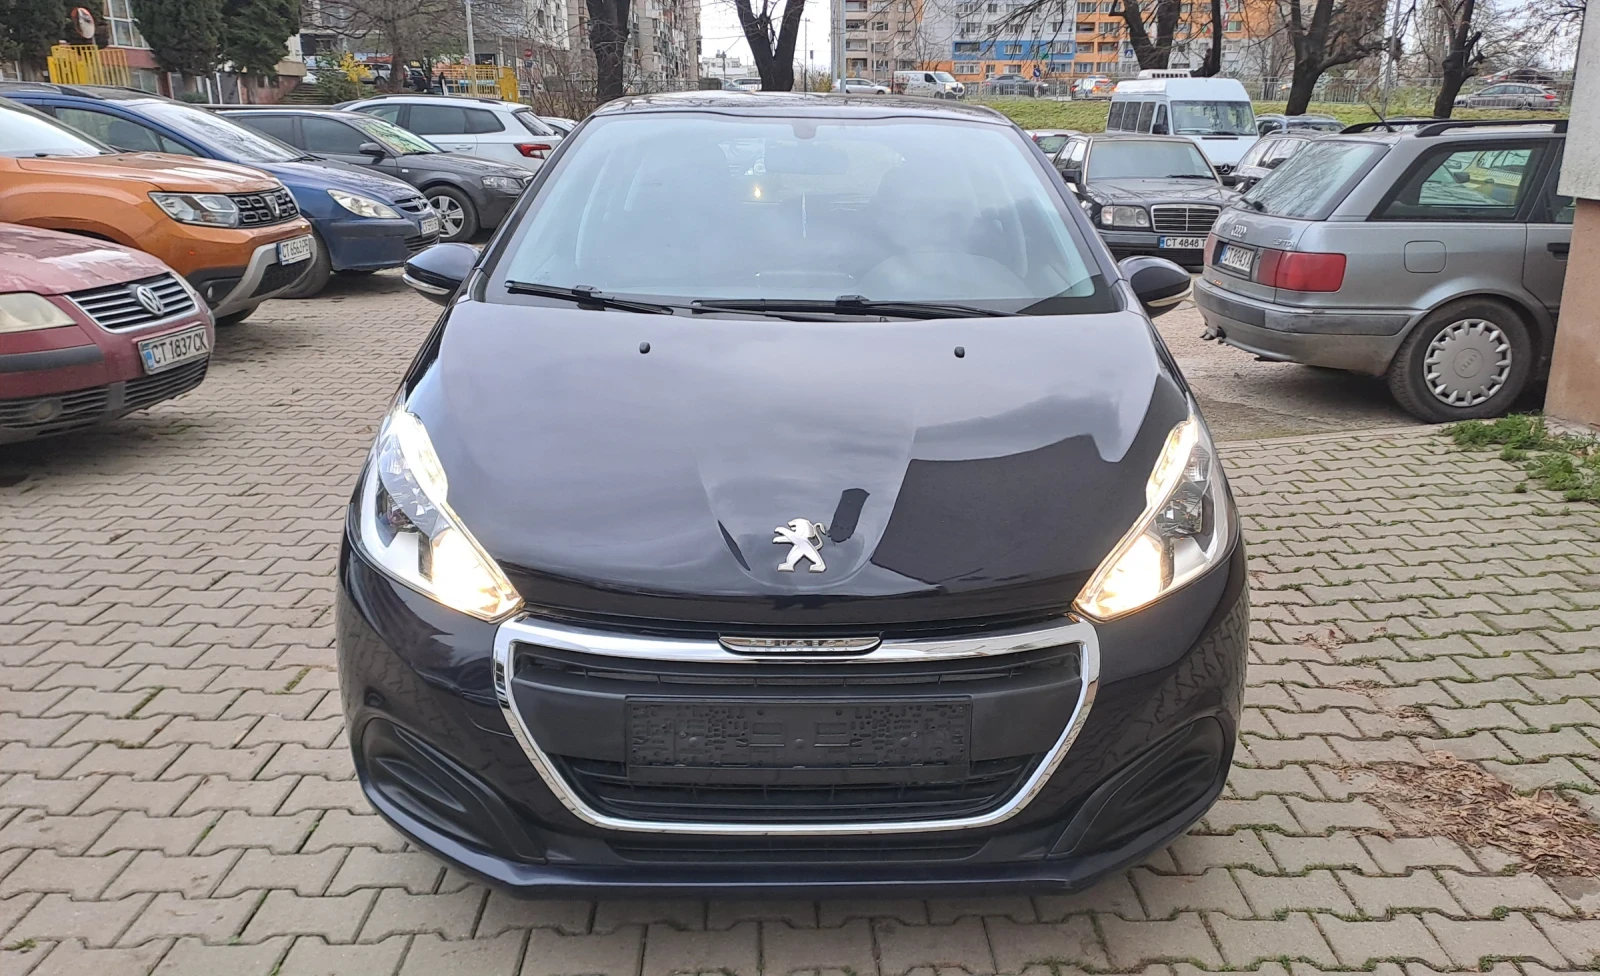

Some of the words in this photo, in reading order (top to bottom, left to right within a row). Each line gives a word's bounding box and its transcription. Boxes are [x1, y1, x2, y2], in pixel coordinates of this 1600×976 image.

[1165, 238, 1177, 247] CT
[1178, 238, 1199, 247] 4848
[282, 243, 289, 258] CT
[152, 342, 166, 363] CT
[169, 335, 192, 360] 1837
[193, 331, 207, 352] CK
